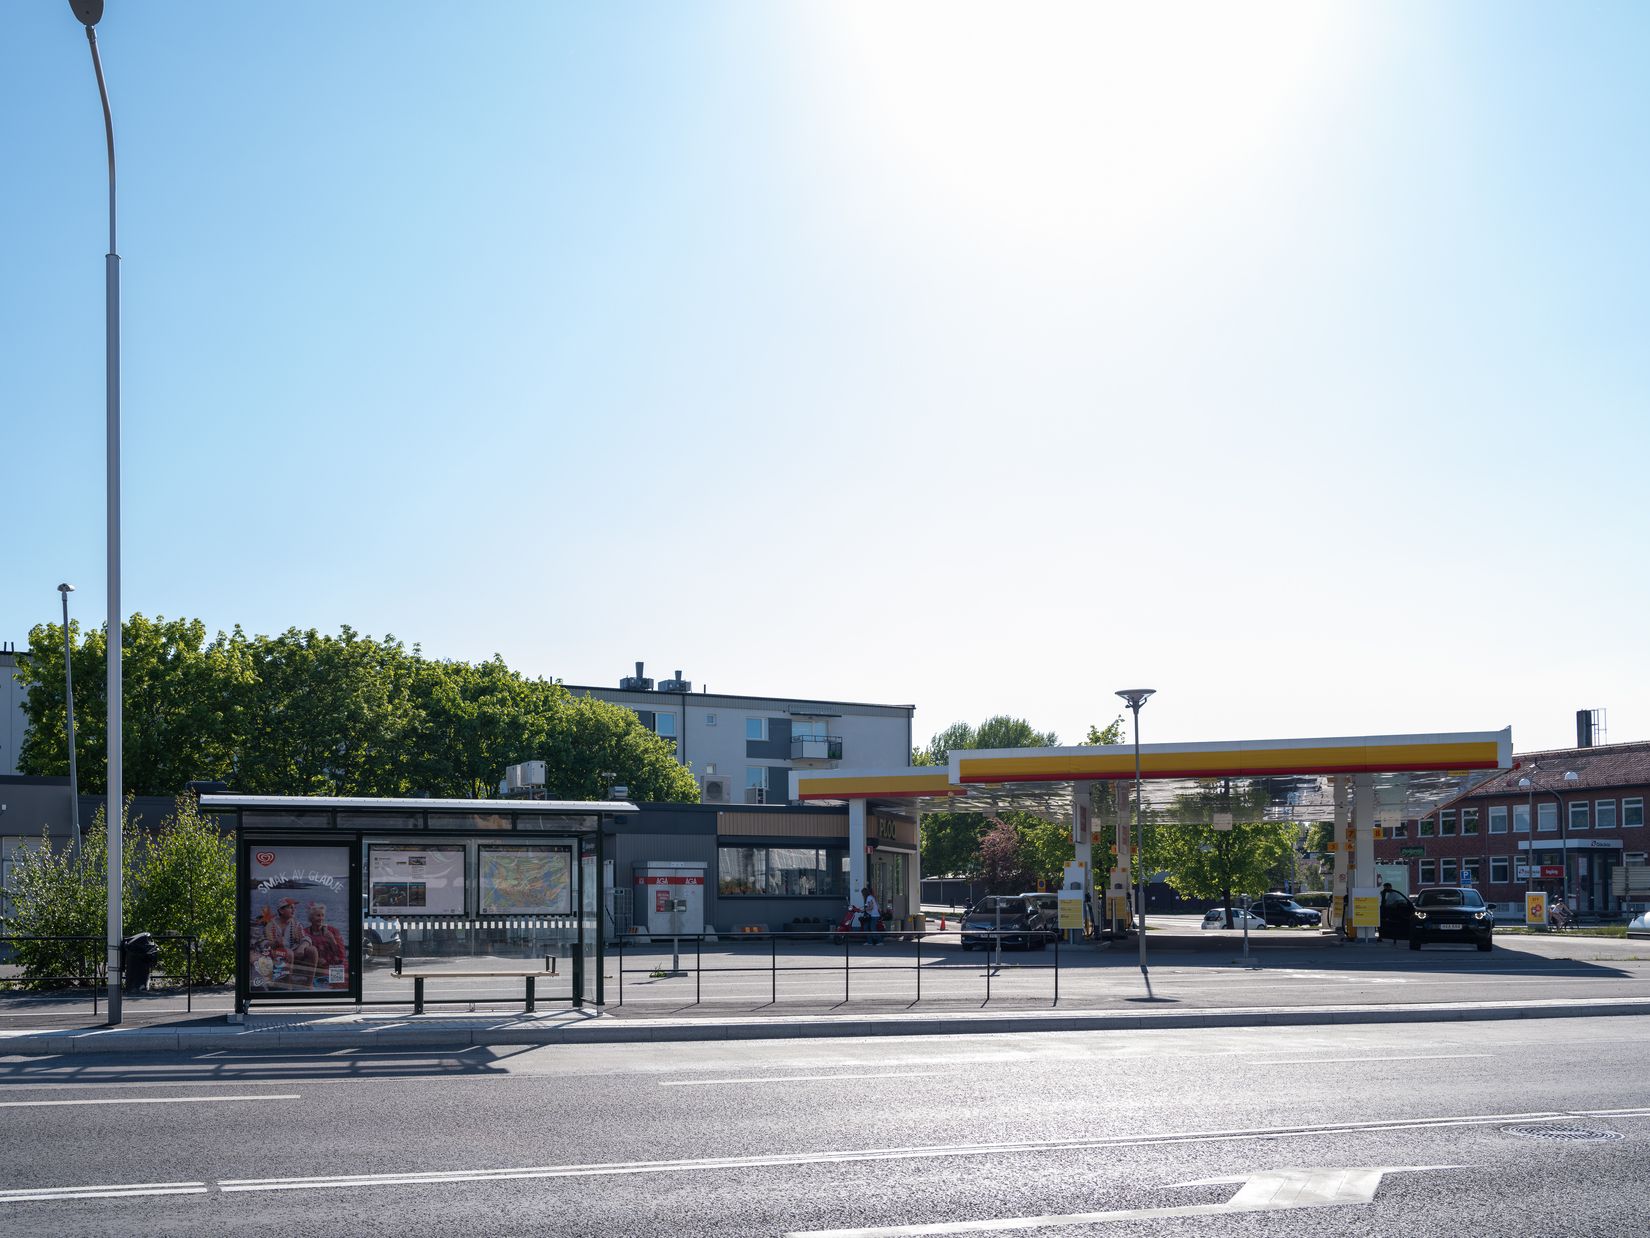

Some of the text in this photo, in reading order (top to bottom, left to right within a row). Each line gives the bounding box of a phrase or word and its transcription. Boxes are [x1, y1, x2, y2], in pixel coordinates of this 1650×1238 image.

[258, 871, 288, 893] SMAK
[292, 870, 304, 880] AV
[1463, 870, 1469, 879] P
